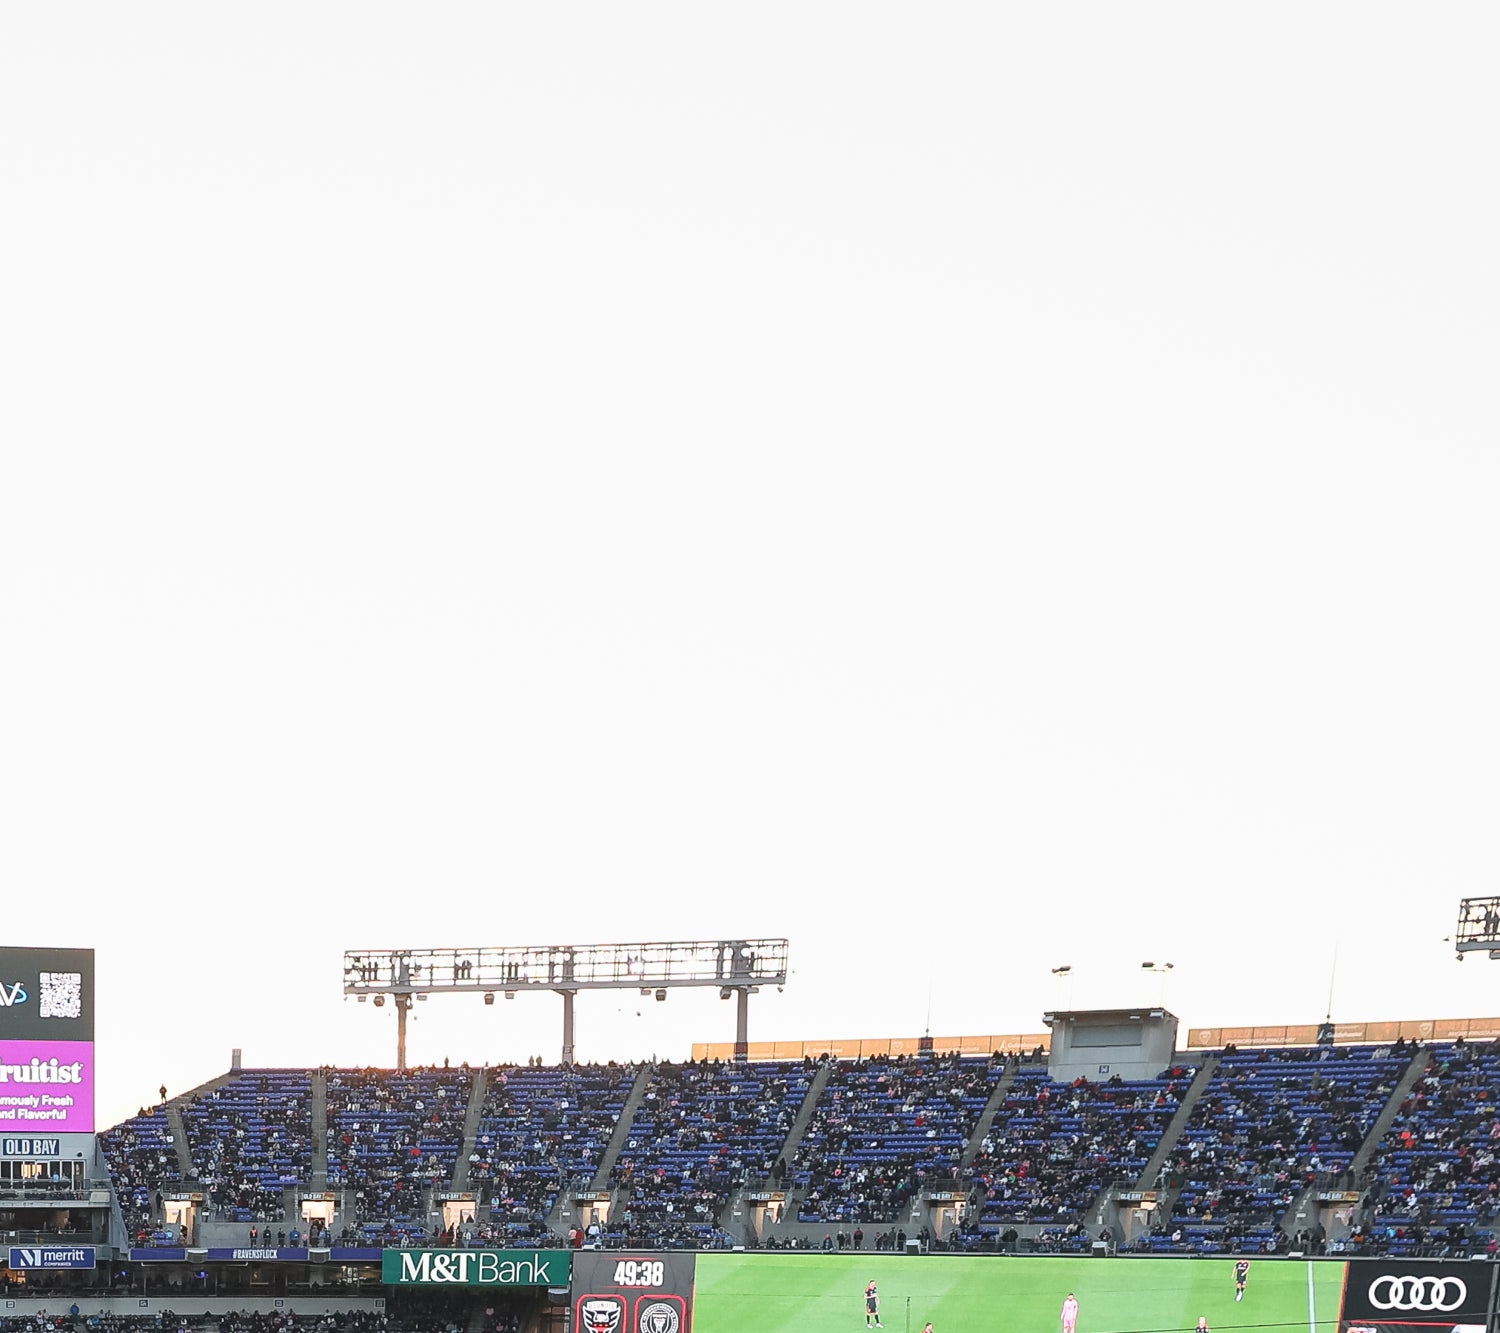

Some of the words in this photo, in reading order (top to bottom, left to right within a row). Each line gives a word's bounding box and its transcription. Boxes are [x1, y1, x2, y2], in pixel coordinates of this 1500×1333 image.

[42, 1094, 74, 1106] Fresh
[18, 1108, 67, 1120] Flavorful
[6, 1140, 31, 1155] OLD
[33, 1140, 58, 1155] BAY
[43, 1250, 86, 1261] merritt
[232, 1249, 279, 1259] #RAVENSFLOCK
[400, 1252, 476, 1283] M&T
[478, 1253, 551, 1283] Bank
[614, 1260, 664, 1287] 49:38
